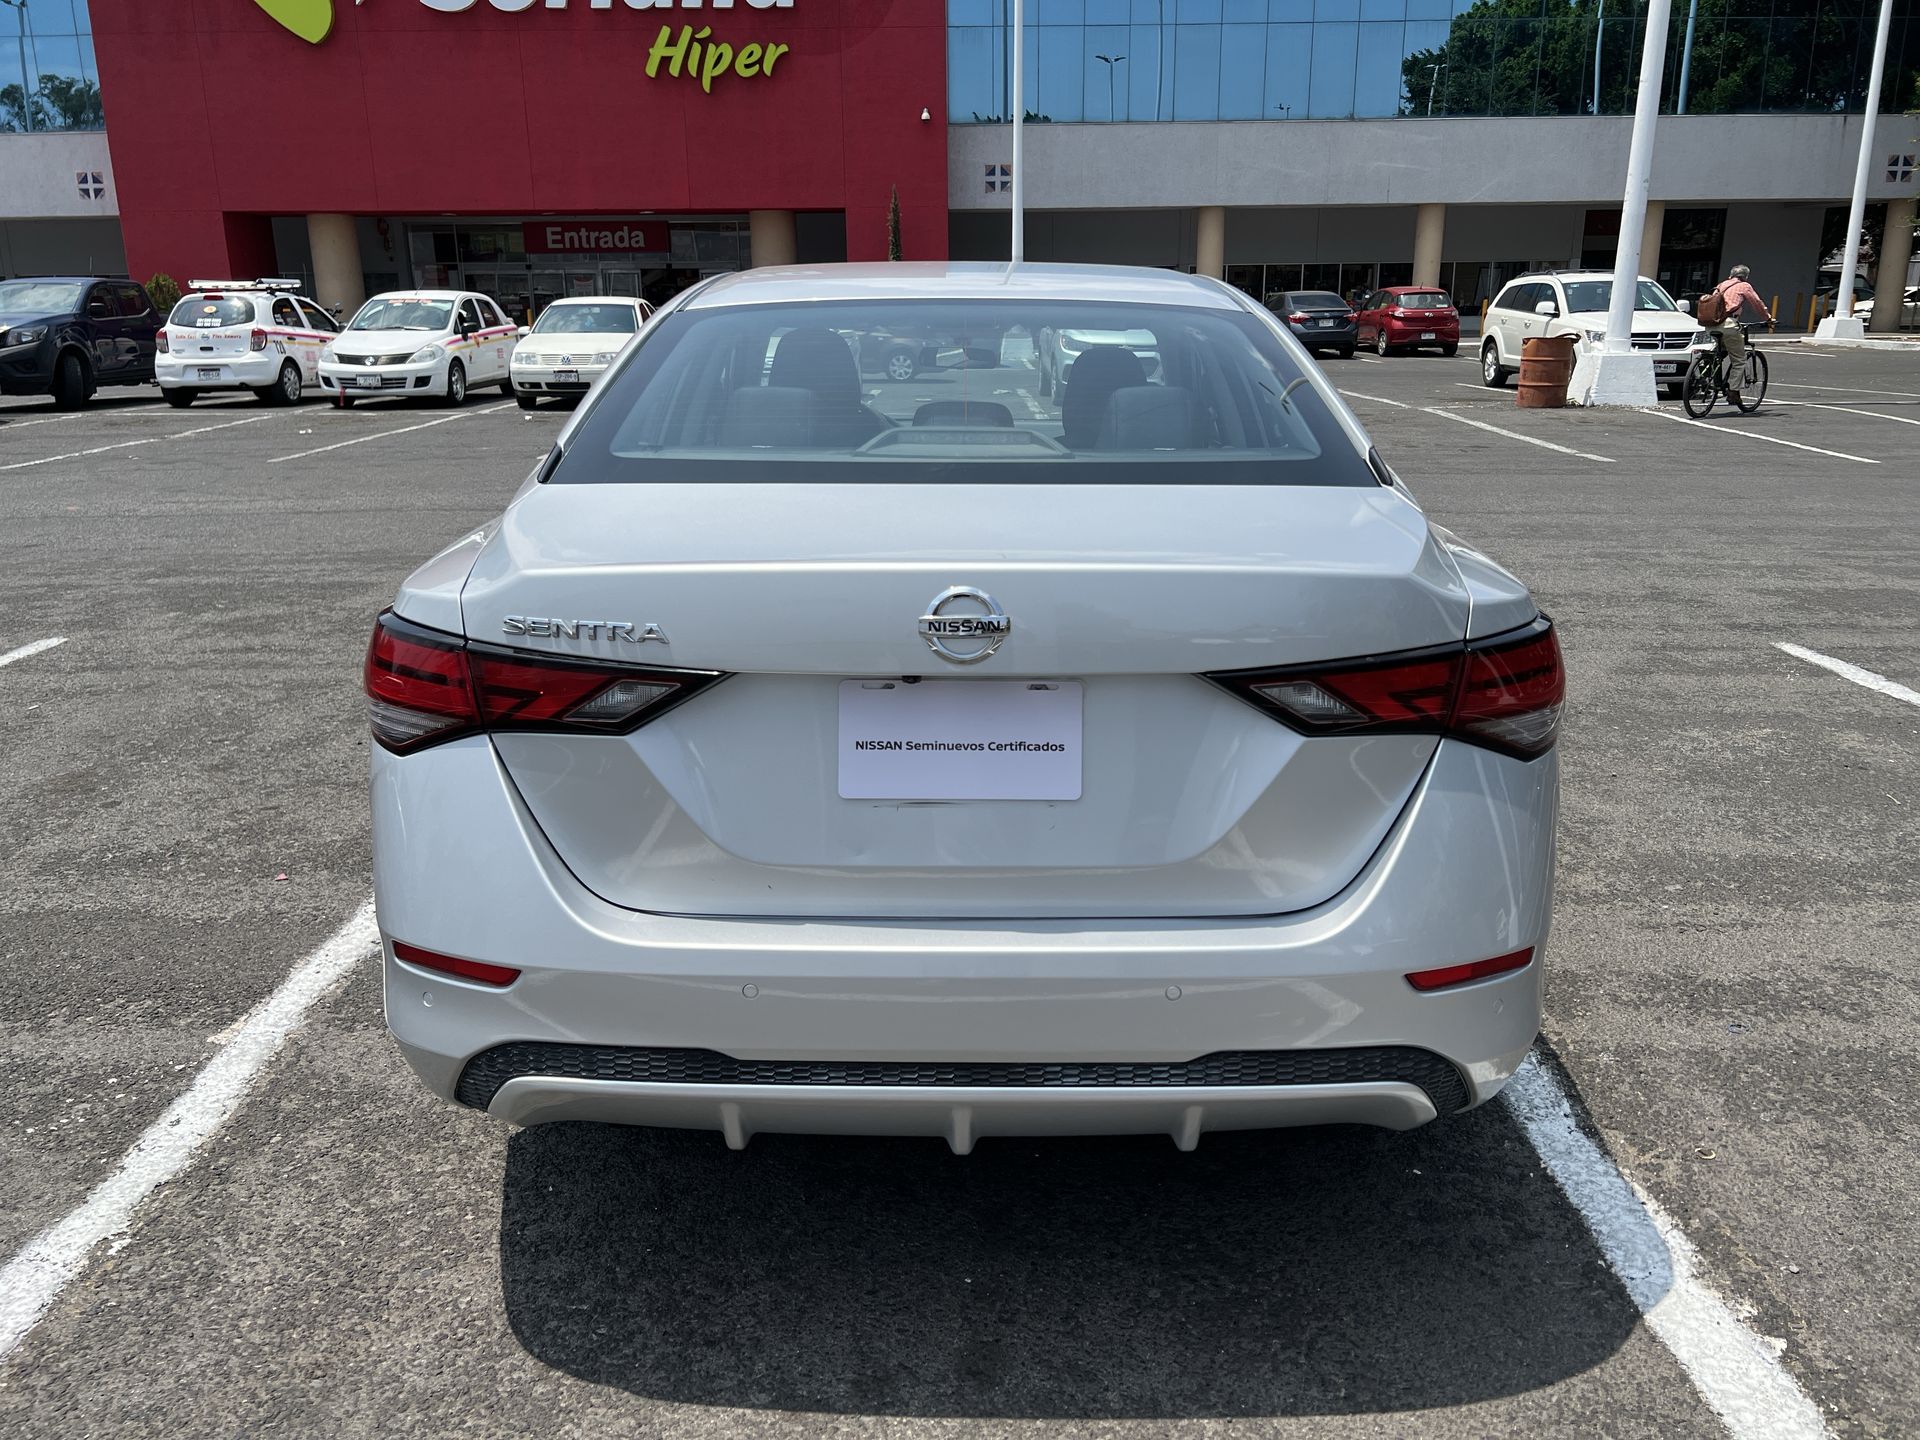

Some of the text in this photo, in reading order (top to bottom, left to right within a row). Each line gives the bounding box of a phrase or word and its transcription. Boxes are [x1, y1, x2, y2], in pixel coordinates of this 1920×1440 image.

[645, 25, 789, 94] Híper
[545, 226, 646, 249] Entrada
[502, 615, 670, 644] SENTRA
[928, 620, 1001, 633] NISSAN
[855, 740, 1065, 752] NISSAN Seminuevos Certificados
